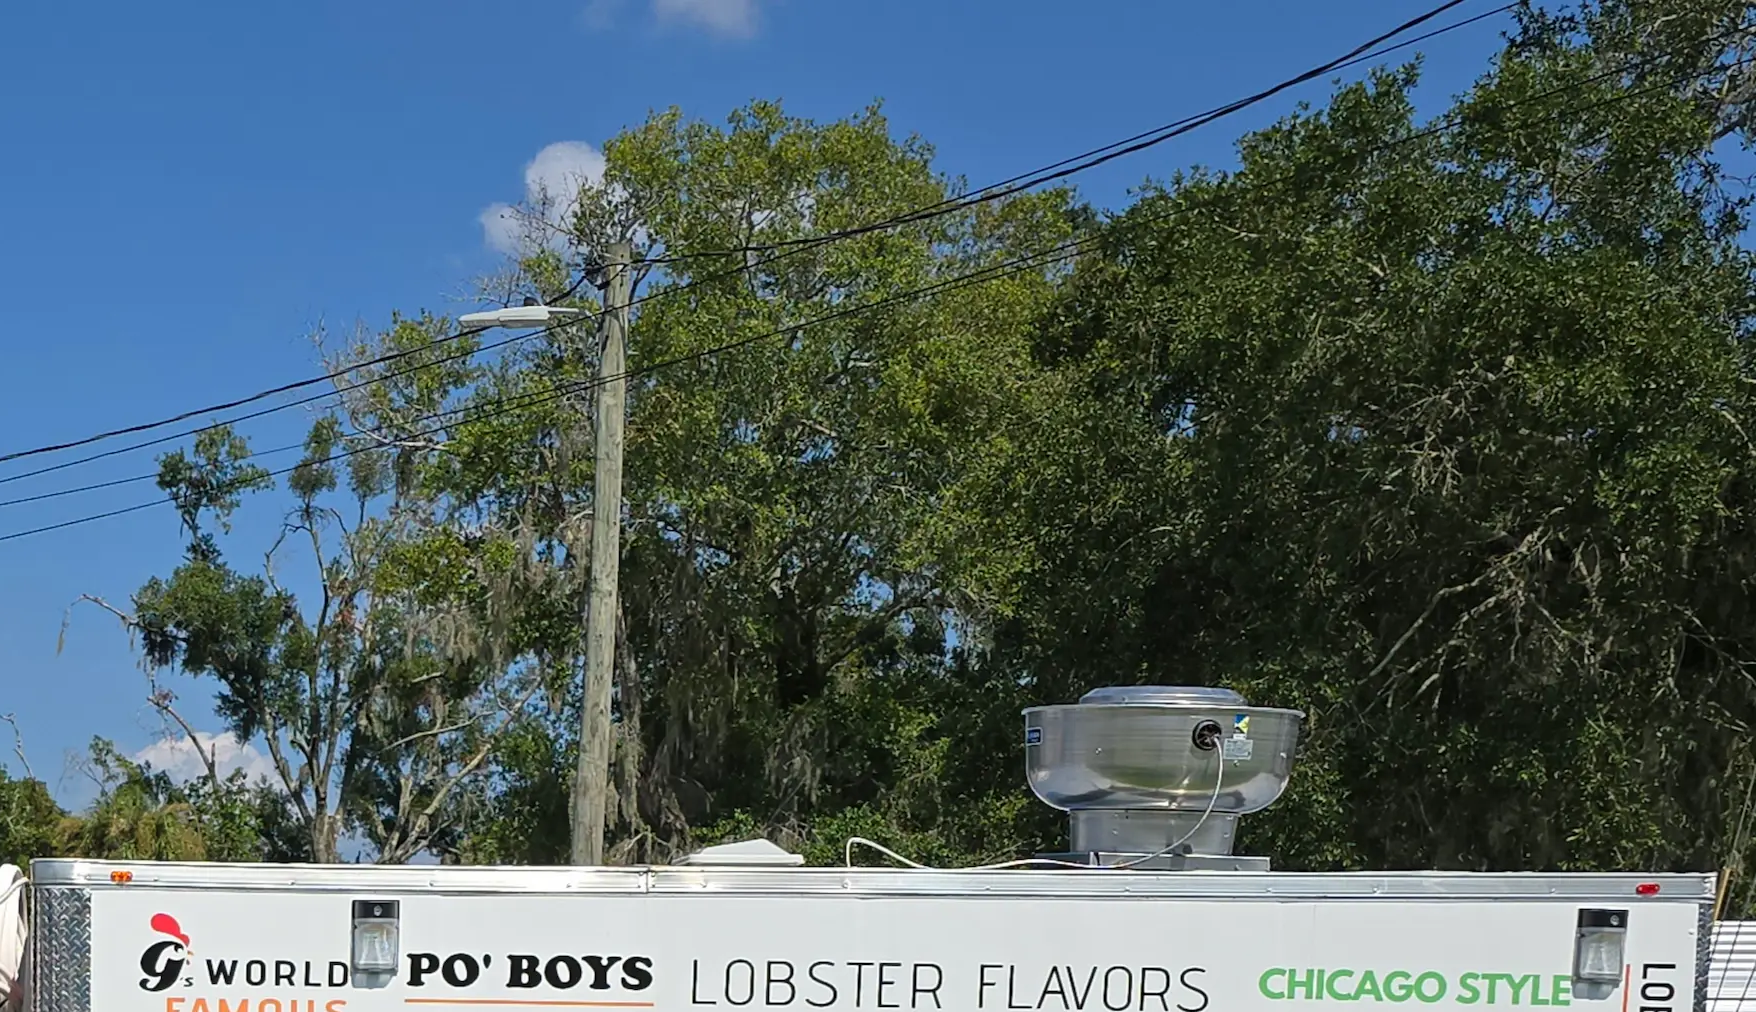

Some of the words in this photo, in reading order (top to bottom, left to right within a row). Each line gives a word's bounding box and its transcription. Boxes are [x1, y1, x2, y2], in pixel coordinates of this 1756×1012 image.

[206, 959, 348, 987] WORLD
[406, 953, 491, 987] PO'
[506, 954, 653, 990] BOYS
[692, 959, 942, 1009] LOBSTER
[979, 964, 1208, 1012] FLAVORS
[1259, 968, 1447, 1003] CHICAGO
[1456, 972, 1571, 1006] STYLE
